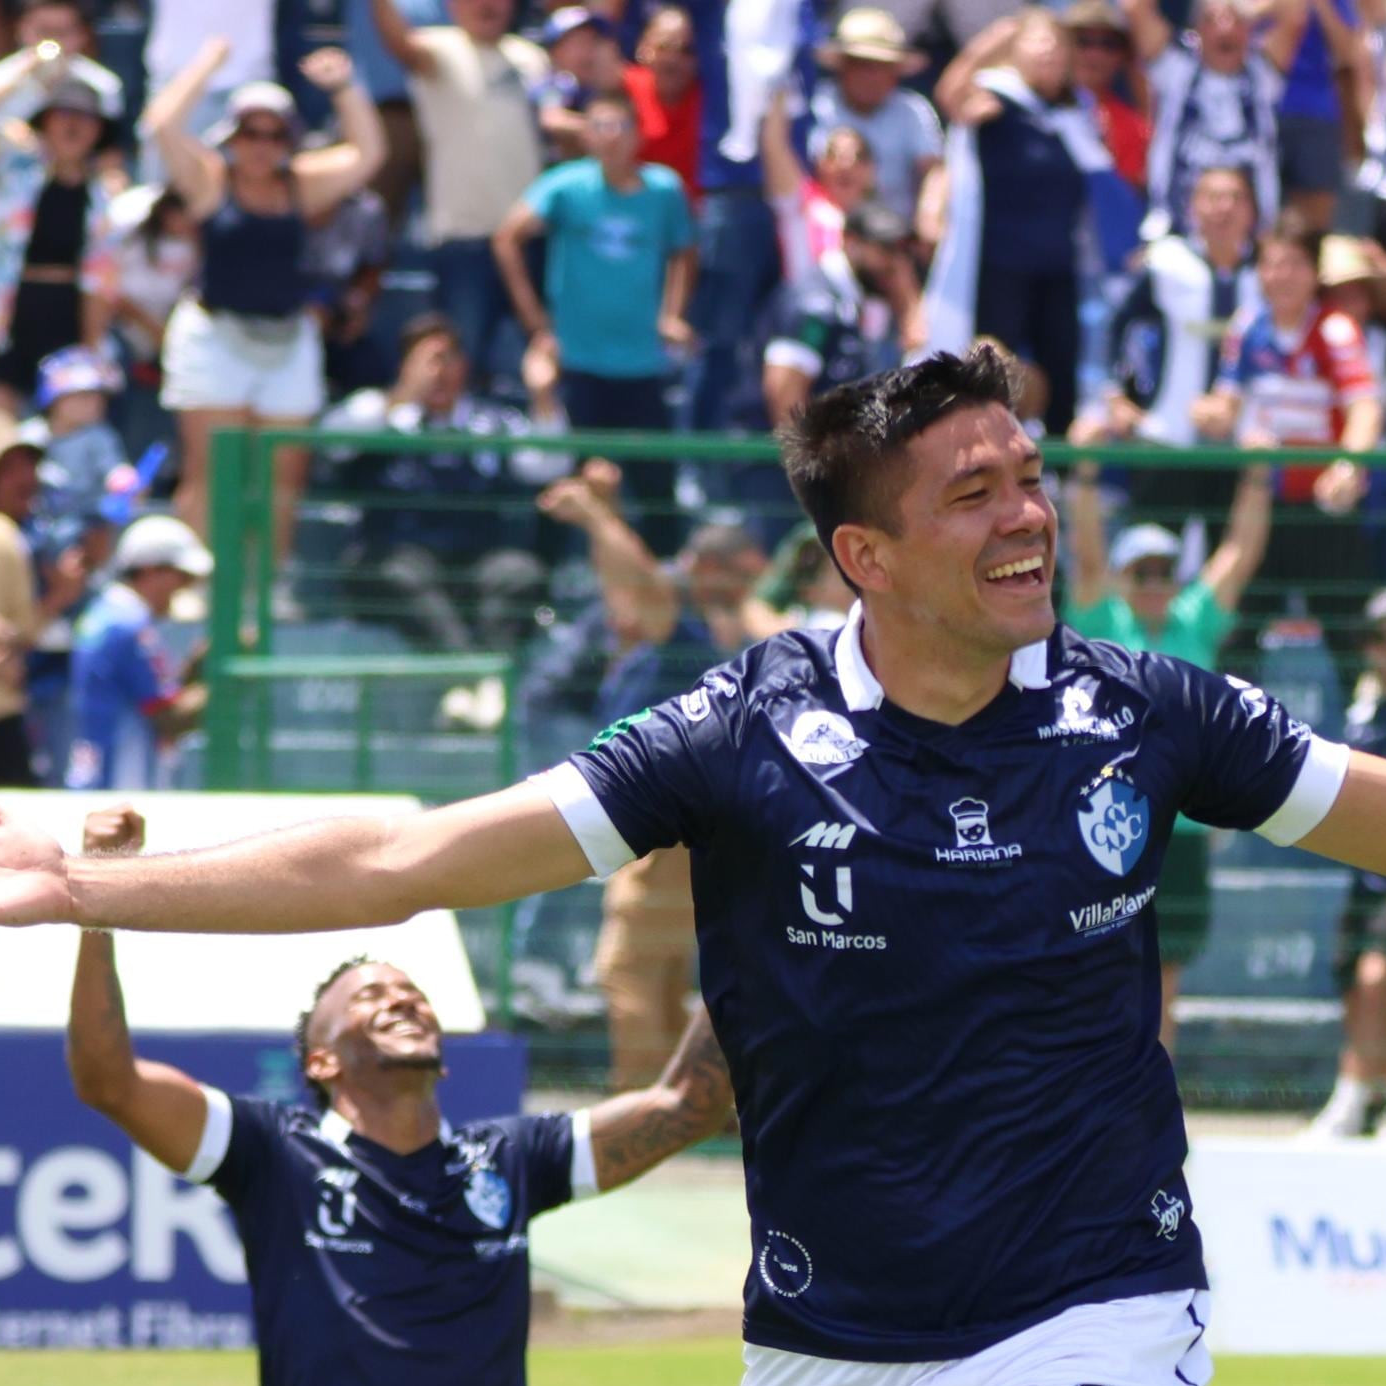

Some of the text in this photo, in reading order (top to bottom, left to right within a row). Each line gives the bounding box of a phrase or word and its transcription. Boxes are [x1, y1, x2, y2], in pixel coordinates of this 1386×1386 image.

[935, 843, 1022, 862] HARIANA
[786, 926, 887, 950] San Marcos
